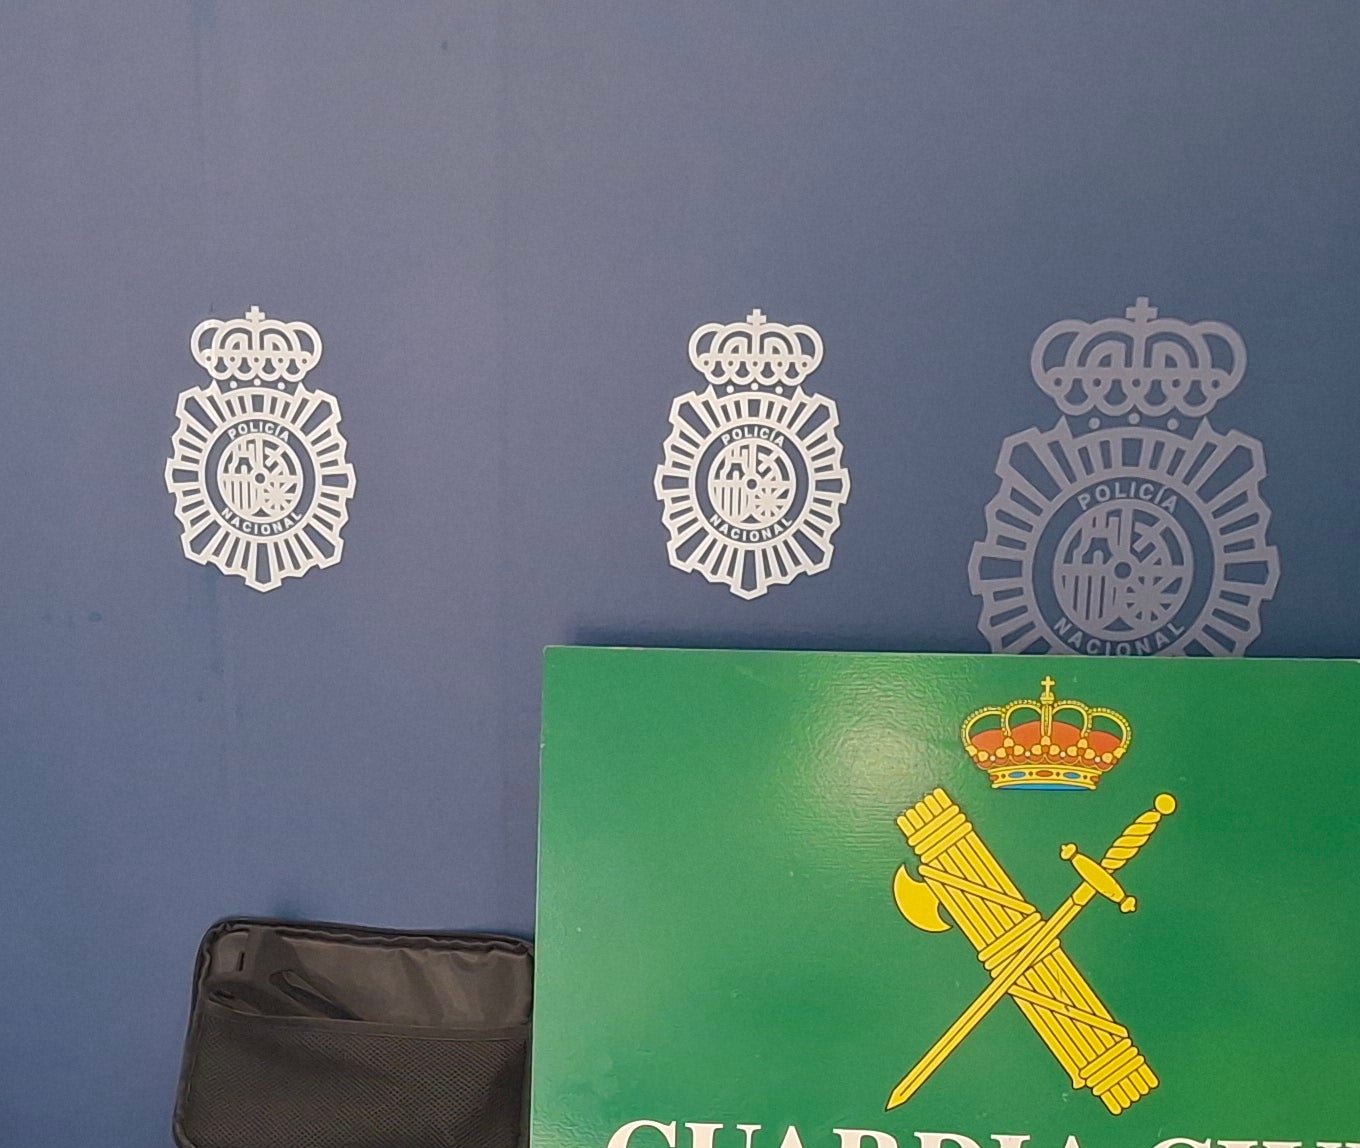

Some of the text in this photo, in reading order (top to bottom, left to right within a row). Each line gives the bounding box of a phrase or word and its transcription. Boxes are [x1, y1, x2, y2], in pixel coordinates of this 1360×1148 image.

[222, 507, 302, 536] NACIONAL
[709, 514, 793, 541] NACIONAL
[1054, 618, 1185, 656] NACIONAL
